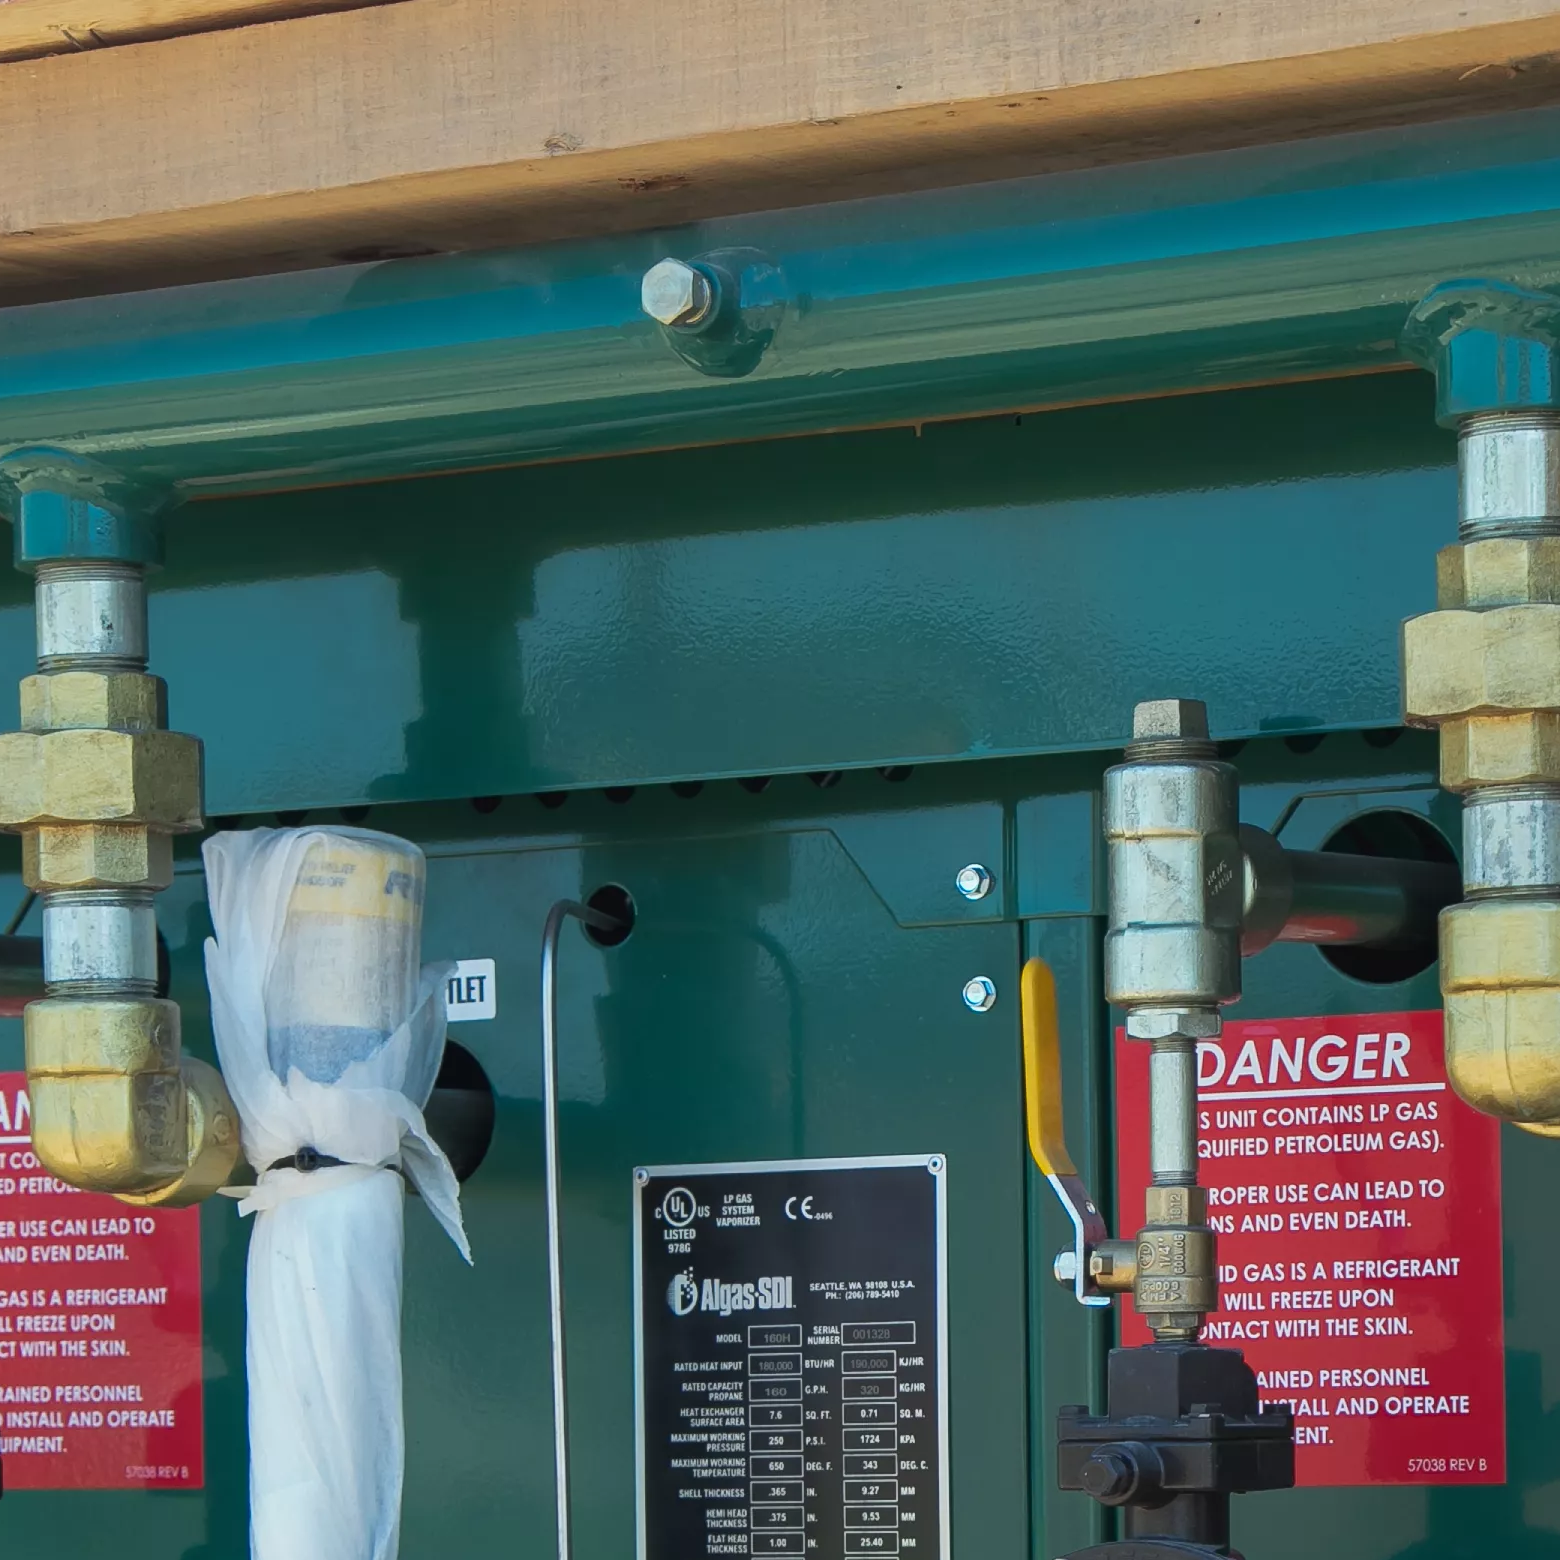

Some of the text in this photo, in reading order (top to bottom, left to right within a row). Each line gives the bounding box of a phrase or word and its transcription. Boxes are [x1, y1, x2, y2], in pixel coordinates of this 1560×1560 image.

[449, 975, 486, 1004] TLET
[1198, 1033, 1411, 1087] DANGER
[1216, 1110, 1258, 1128] UNIT
[1262, 1104, 1364, 1126] CONTAINS
[1370, 1104, 1390, 1122] LP
[1396, 1101, 1438, 1121] GAS
[1198, 1130, 1444, 1158] QUIFIED PETROLEUM GAS).
[1209, 1178, 1444, 1206] ROPER USE CAN LEAD TO
[20, 1220, 47, 1237] USE
[50, 1219, 87, 1236] CAN
[92, 1218, 130, 1236] LEAD
[134, 1217, 155, 1234] TO
[31, 1245, 71, 1262] EVEN
[75, 1244, 129, 1261] DEATH.
[1244, 1262, 1285, 1282] GAS
[1291, 1262, 1306, 1280] IS
[1312, 1262, 1327, 1280] A
[1333, 1258, 1460, 1279] REFRIGERANT
[1224, 1288, 1394, 1311] WILL FREEZE UPON
[1199, 1317, 1413, 1340] NTACT WITH THE SKIN.
[1257, 1368, 1430, 1388] AINED PERSONNEL
[1259, 1396, 1469, 1416] ITALL AND OPERATE
[1408, 1458, 1446, 1472] 57038
[1450, 1458, 1475, 1471] REV
